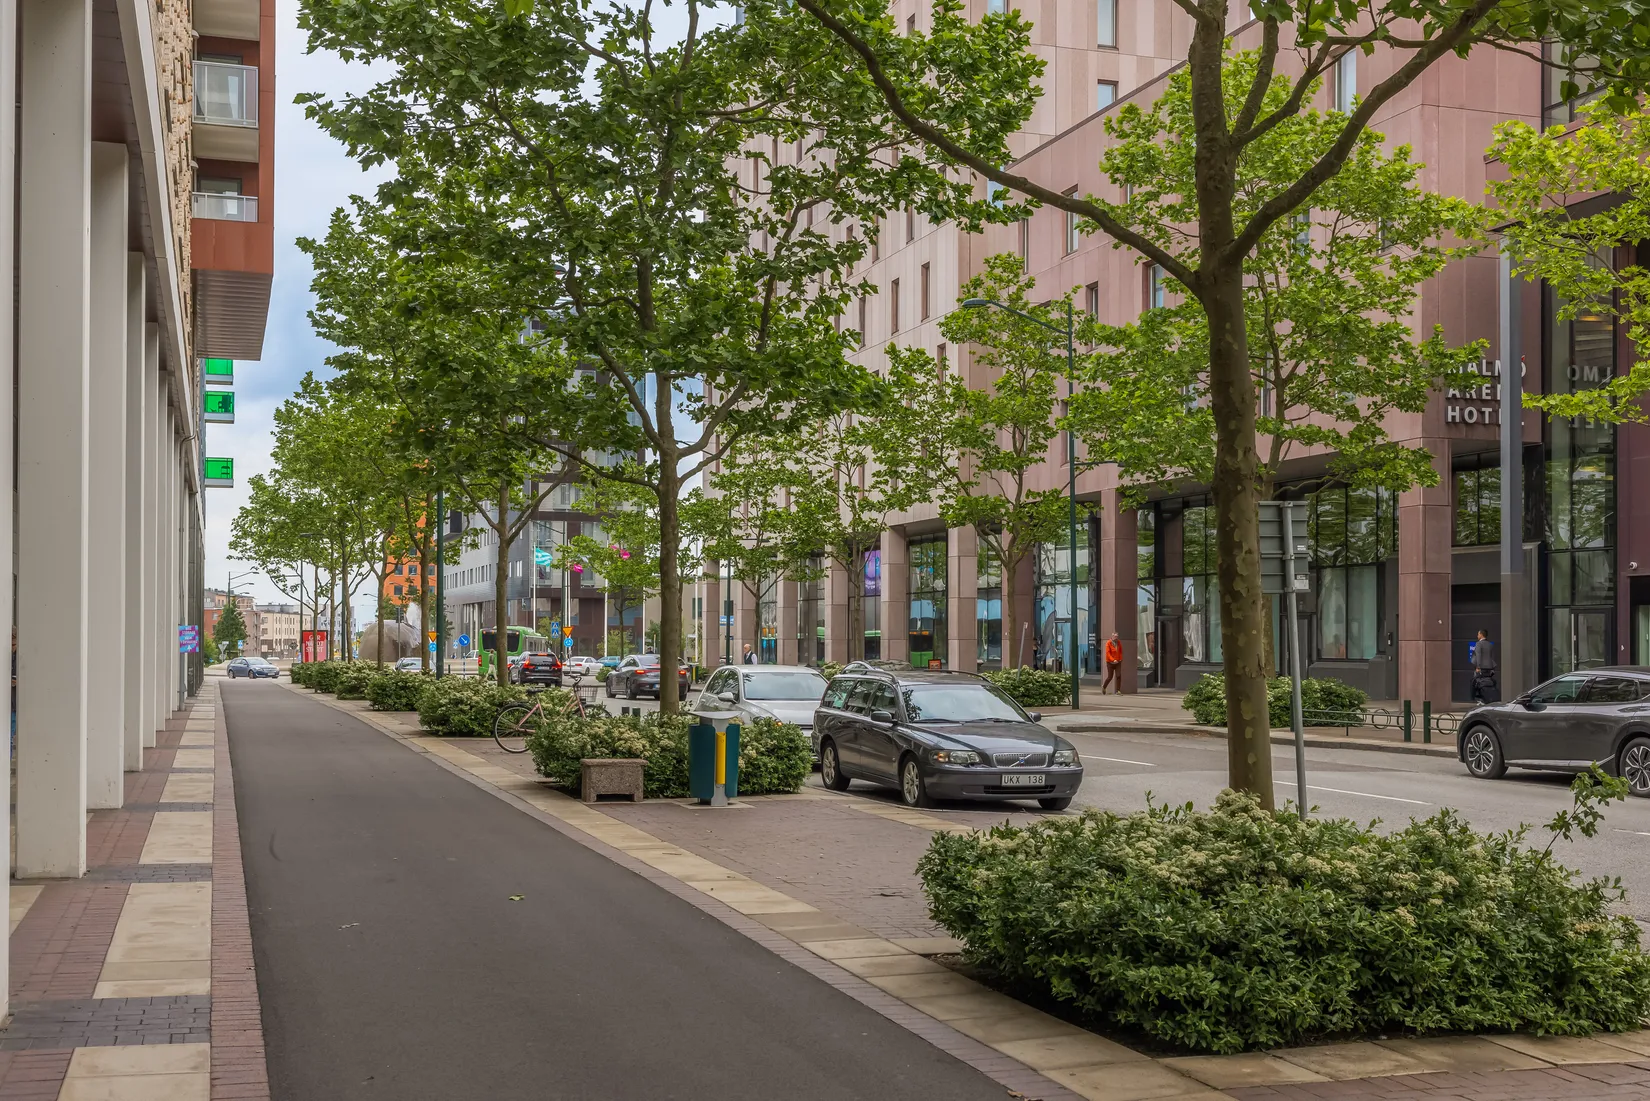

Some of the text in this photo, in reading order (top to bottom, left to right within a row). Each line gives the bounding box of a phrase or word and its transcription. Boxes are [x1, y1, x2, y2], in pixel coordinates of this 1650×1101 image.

[1447, 405, 1526, 426] HOT
[1003, 775, 1044, 784] UKX 138
